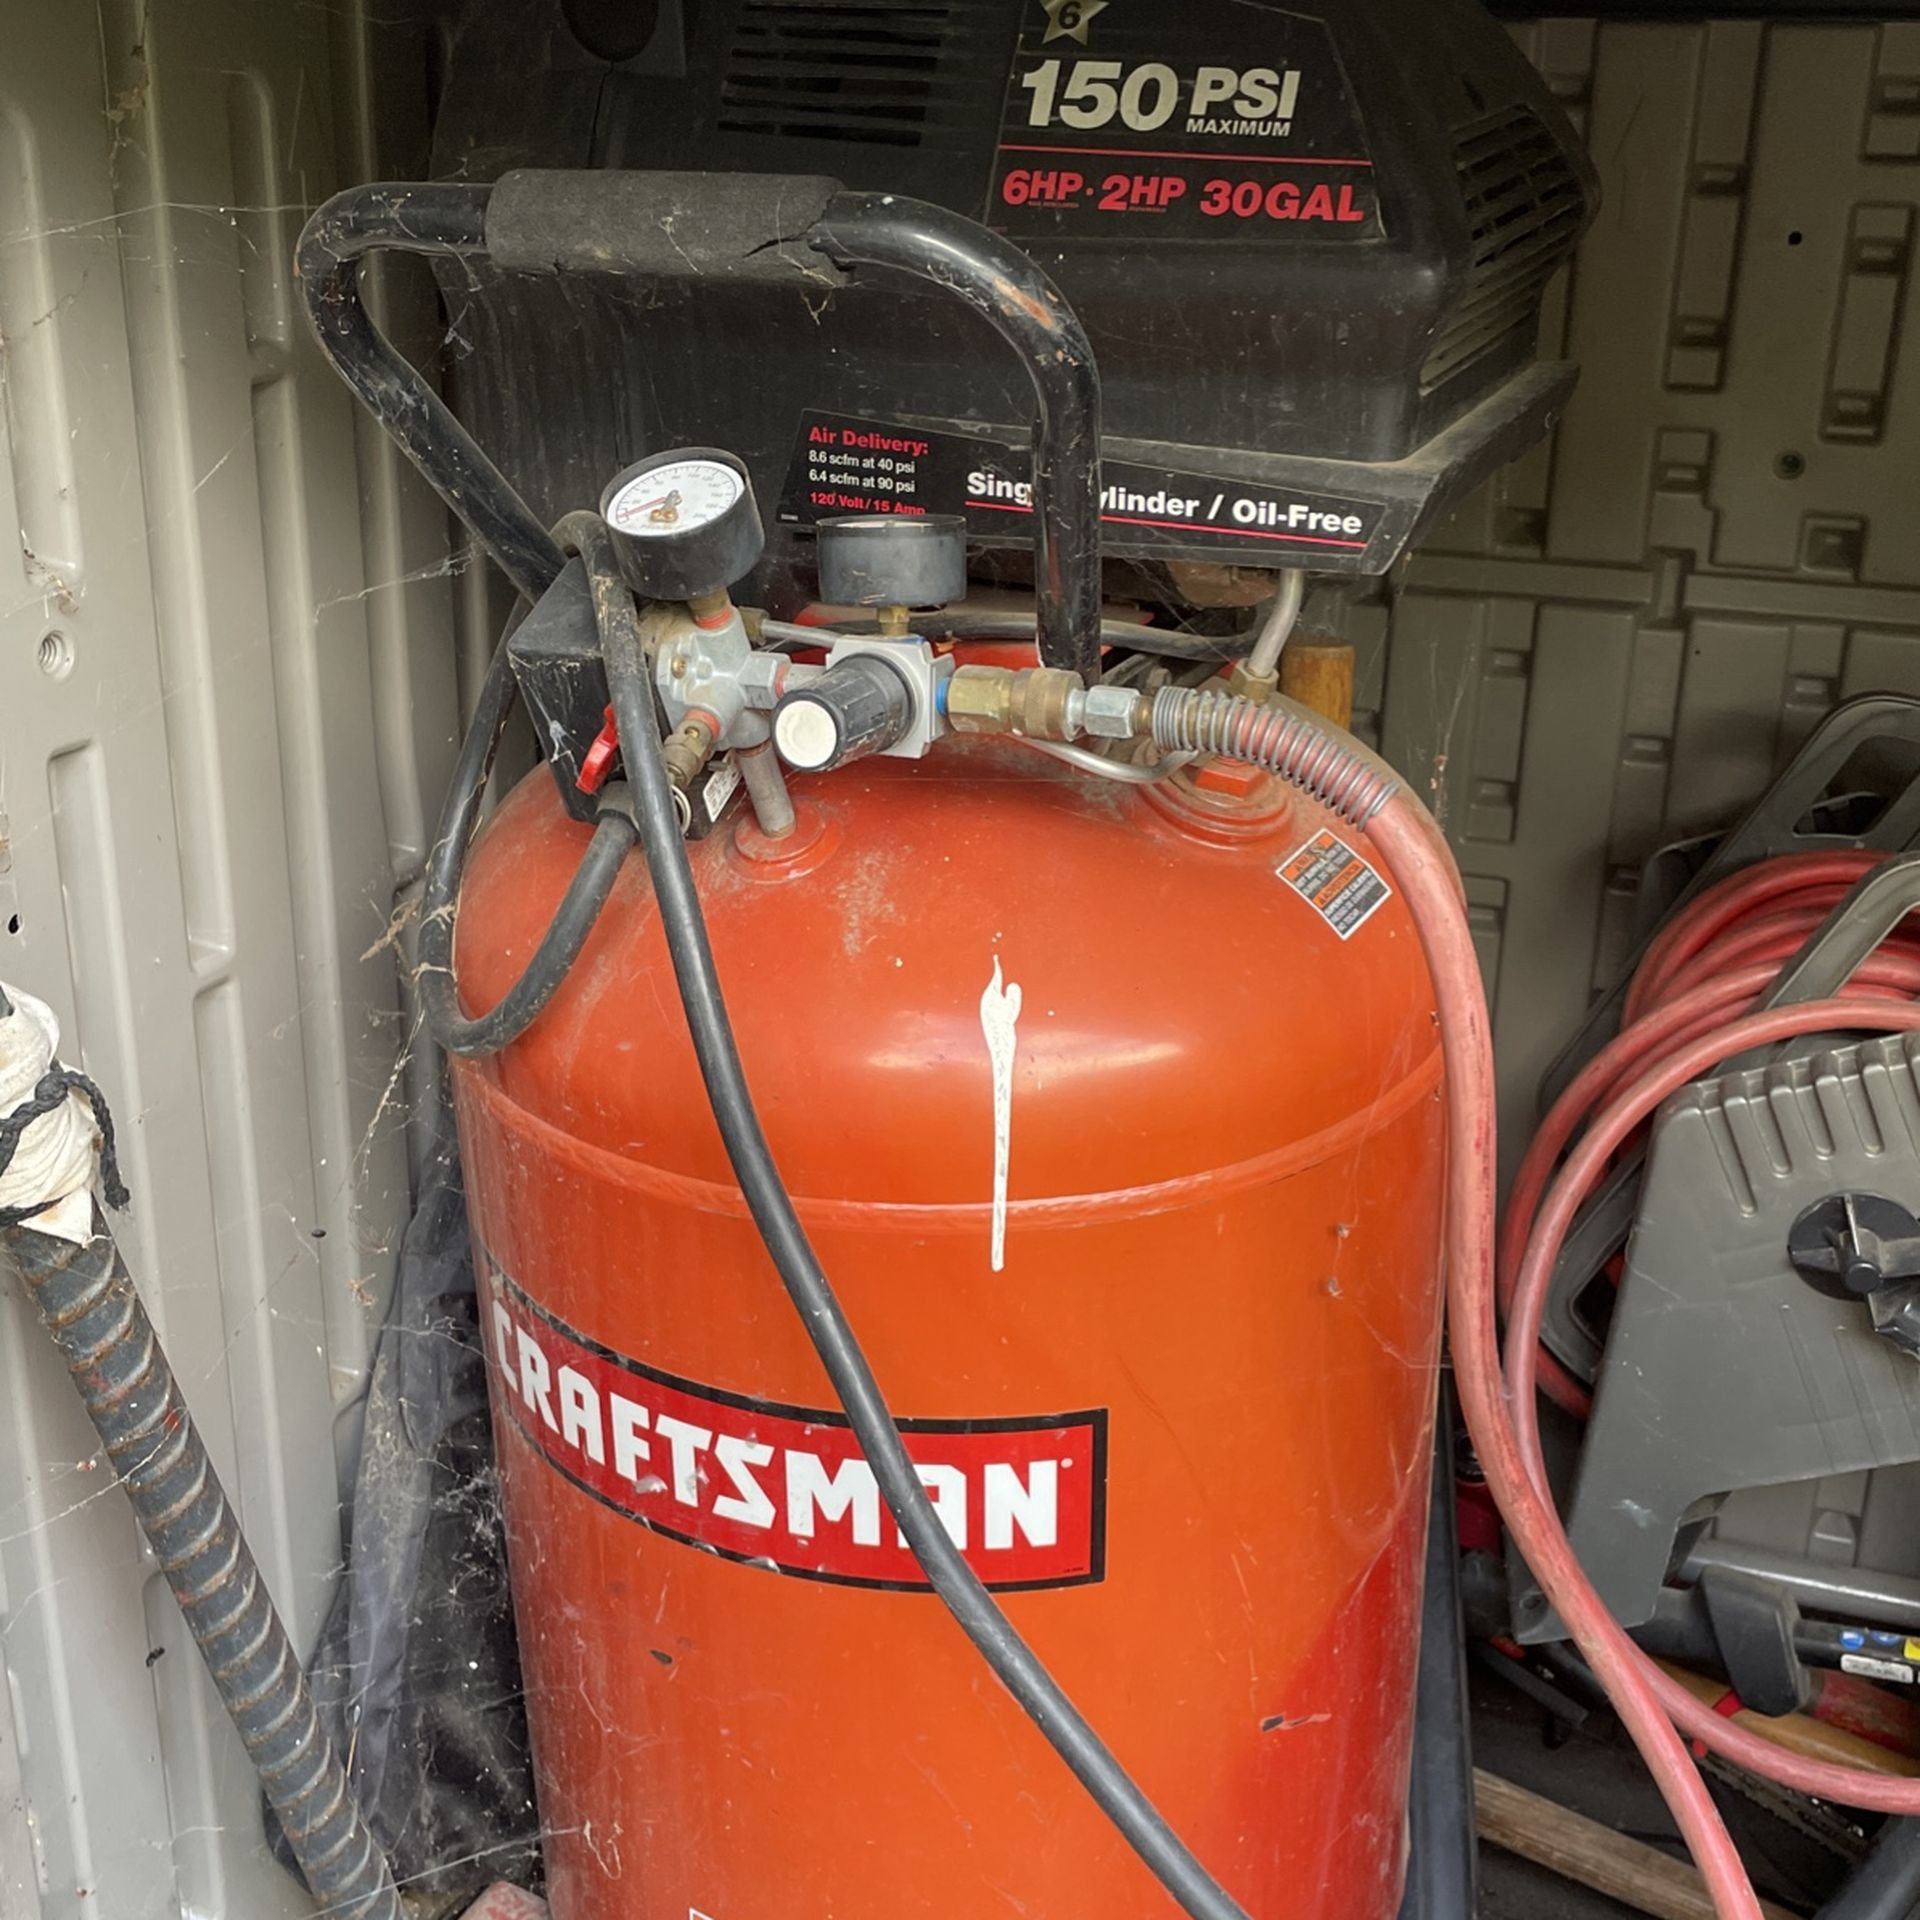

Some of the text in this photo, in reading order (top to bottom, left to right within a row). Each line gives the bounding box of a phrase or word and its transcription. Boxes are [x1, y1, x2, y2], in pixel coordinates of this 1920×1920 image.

[1059, 1, 1082, 29] 6
[1022, 59, 1301, 132] 150 PSI
[1186, 118, 1291, 137] MAXIMUM
[1200, 179, 1365, 222] 30GAL
[808, 426, 928, 457] Air Delivery:
[808, 449, 915, 475] 8.6 scfm at 40 psi
[808, 468, 915, 494] 6.4 scfm at 90 psi
[810, 491, 836, 506] 120
[838, 494, 864, 510] Volt
[873, 500, 890, 512] 15
[966, 471, 1034, 508] Sing
[1100, 486, 1200, 518] linder
[1232, 499, 1363, 535] Oil-Free
[492, 1299, 1058, 1551] CRAFTSMAN
